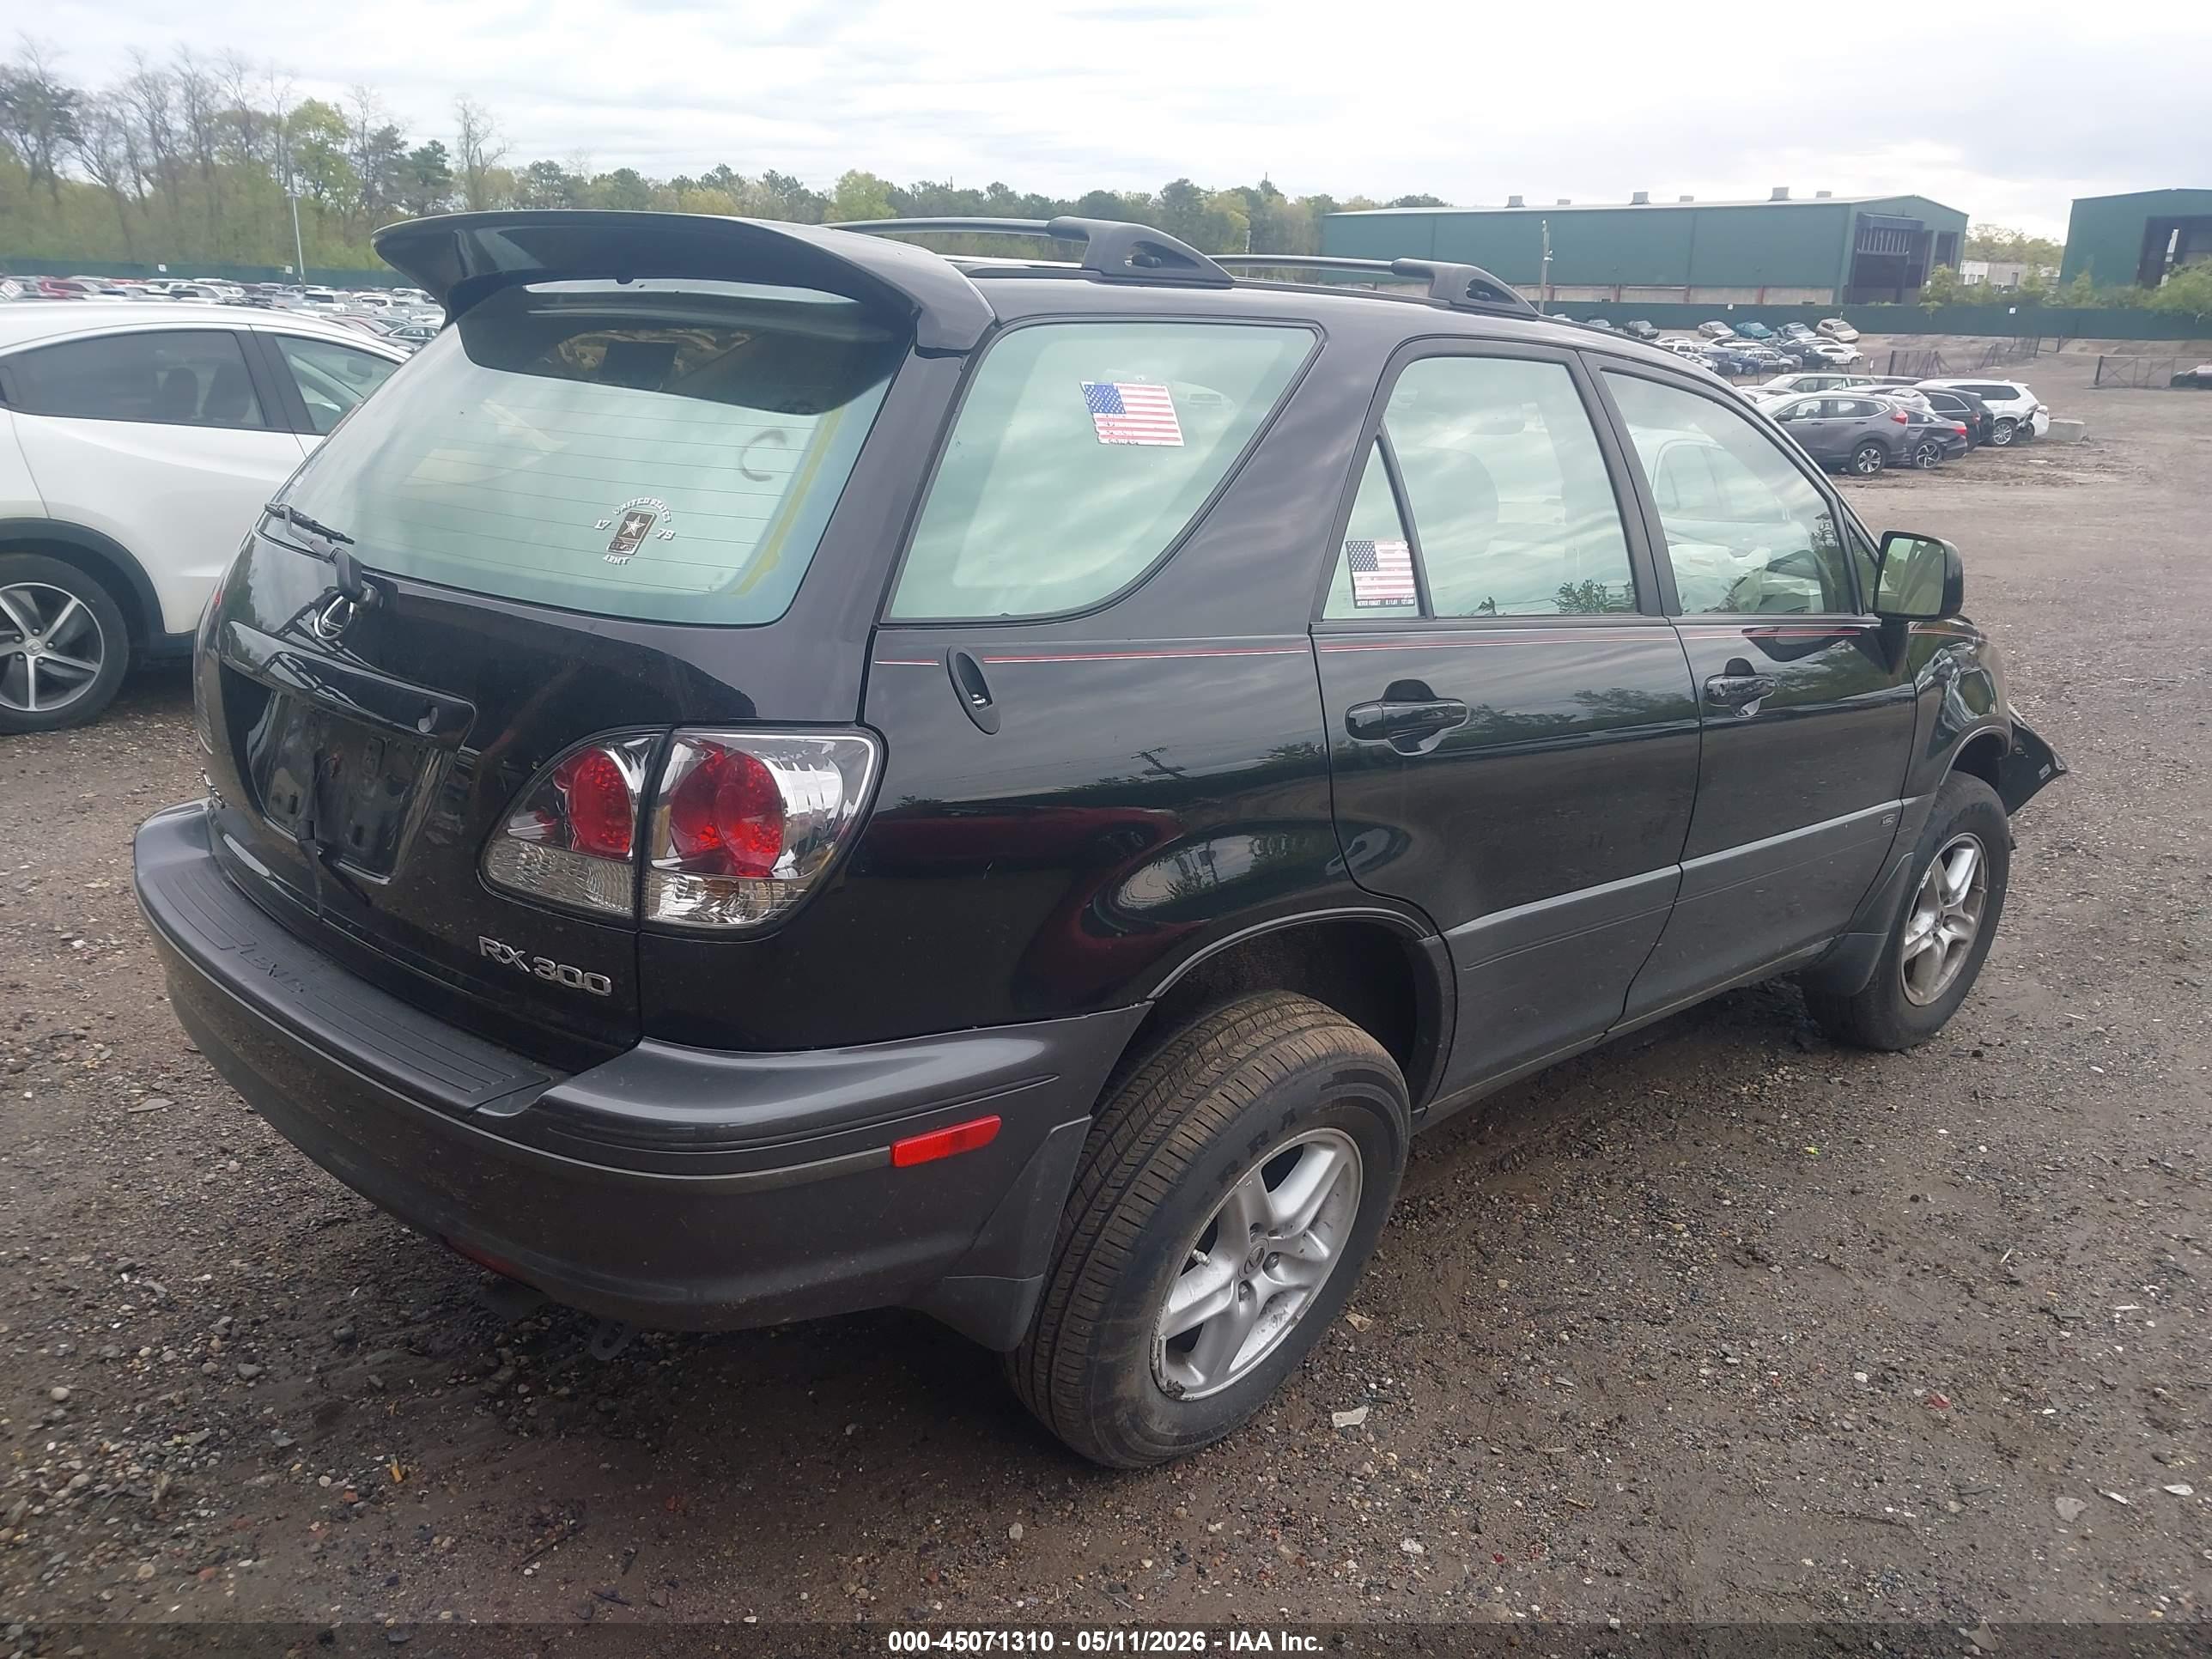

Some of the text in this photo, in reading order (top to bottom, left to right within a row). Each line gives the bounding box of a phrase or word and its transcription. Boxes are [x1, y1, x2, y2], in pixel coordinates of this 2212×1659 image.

[612, 497, 672, 523] UNITED STATES
[594, 520, 611, 530] 17
[603, 554, 629, 565] ARMY
[478, 935, 612, 997] RX 300
